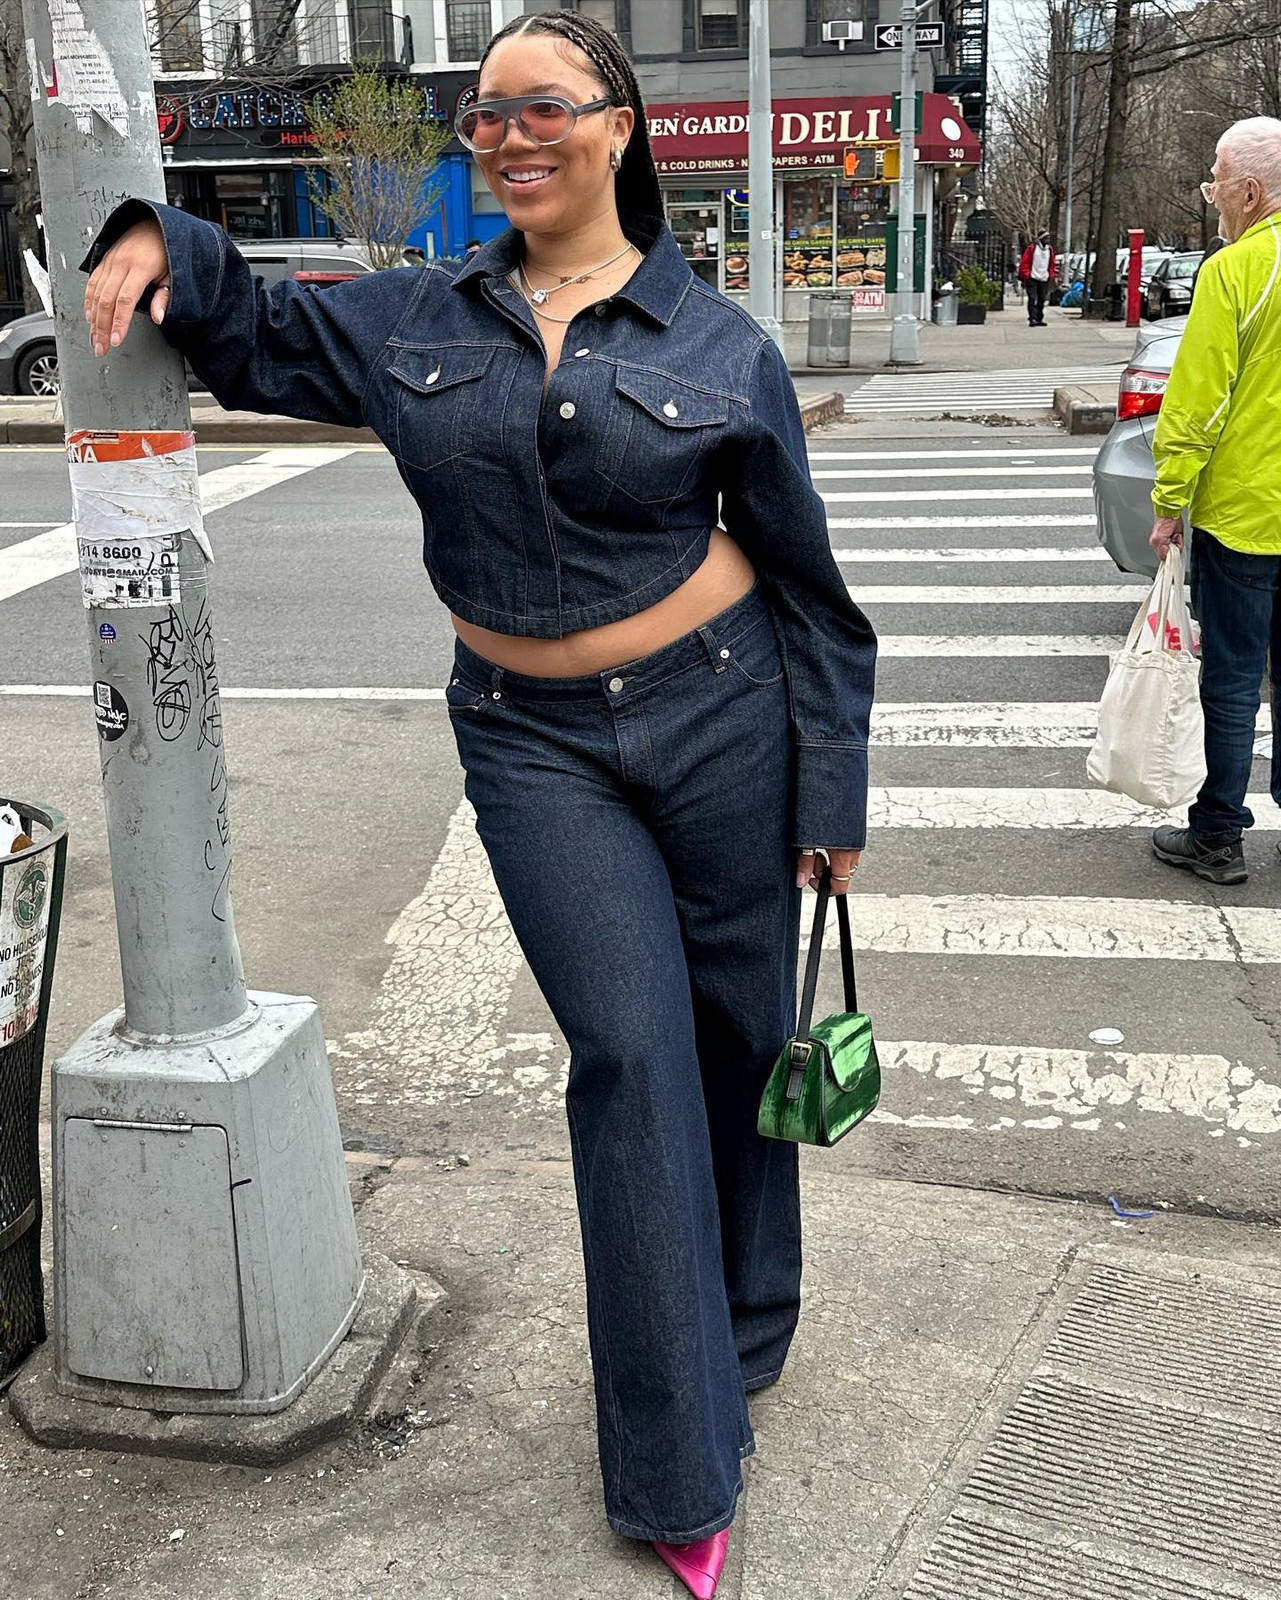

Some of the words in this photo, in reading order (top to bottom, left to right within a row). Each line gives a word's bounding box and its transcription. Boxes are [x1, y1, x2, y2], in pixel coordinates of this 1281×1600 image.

[647, 118, 680, 136] EN
[682, 114, 775, 136] GARD
[948, 148, 965, 159] 340
[669, 161, 697, 171] COLD
[698, 159, 735, 169] DRINKS
[814, 155, 835, 165] ATM
[864, 291, 883, 306] ATM
[102, 546, 142, 559] 8600
[1, 982, 14, 998] NO
